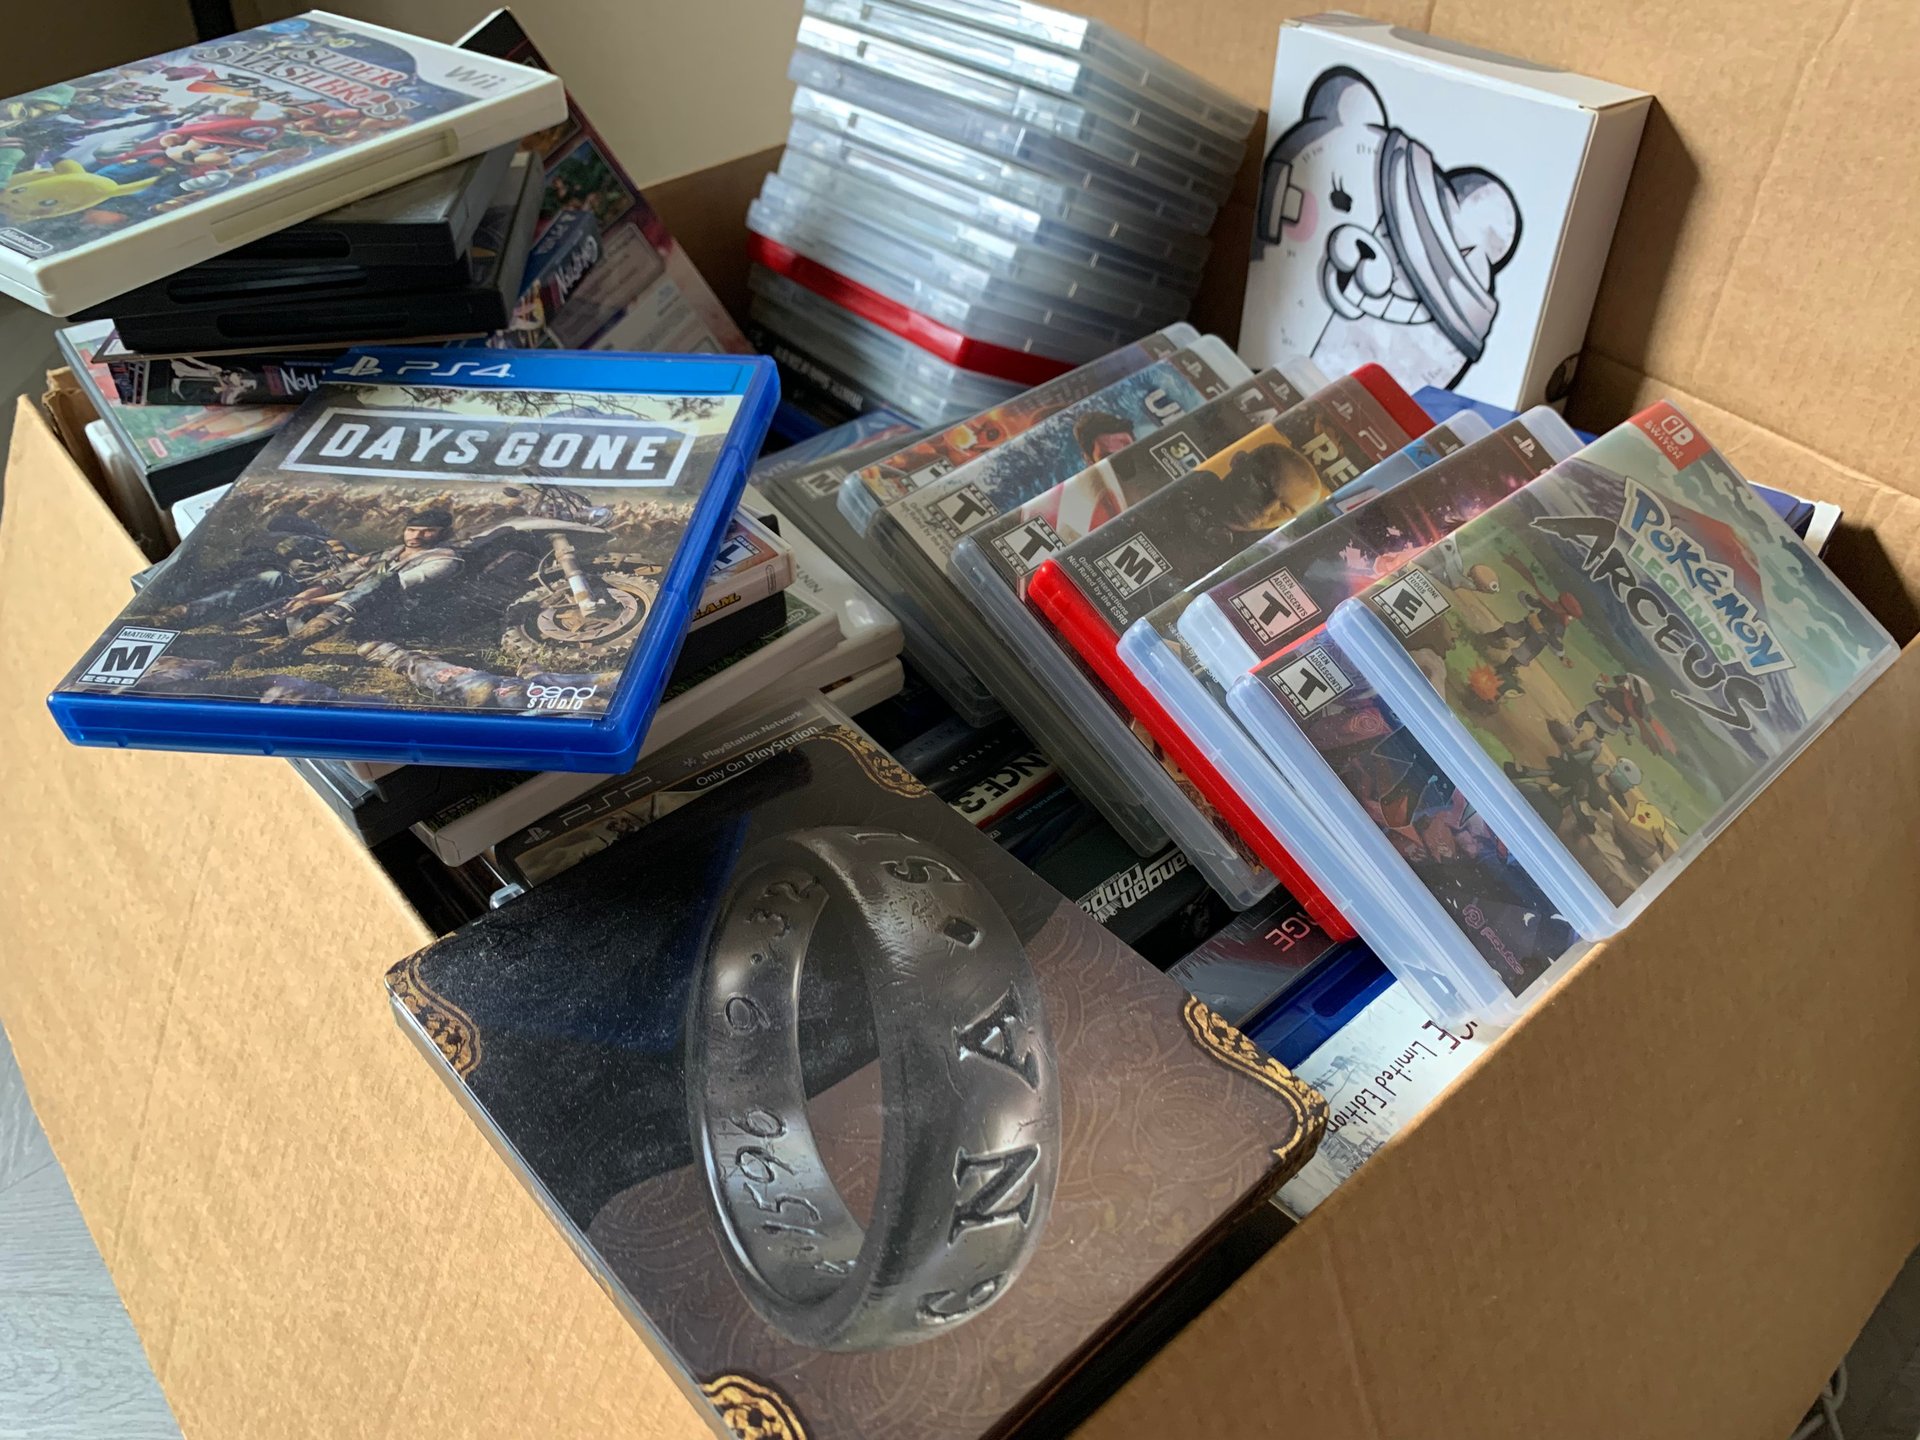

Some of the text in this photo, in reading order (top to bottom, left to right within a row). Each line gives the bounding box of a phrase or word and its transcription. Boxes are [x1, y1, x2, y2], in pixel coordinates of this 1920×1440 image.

[190, 46, 318, 93] SMASH
[298, 49, 408, 88] SUPER
[444, 63, 507, 90] Wii
[397, 361, 512, 378] PS4
[318, 421, 668, 473] DAYS GONE
[1644, 419, 1685, 460] SWITCH
[952, 491, 987, 526] T
[1019, 524, 1056, 562] T
[1136, 535, 1158, 560] MATURE
[1097, 560, 1129, 598] ESRB
[1114, 544, 1155, 586] M
[1279, 572, 1296, 590] TEEN
[1066, 555, 1129, 626] Not Rated by the ESRB
[1078, 556, 1129, 616] Online Interactions
[1273, 576, 1309, 617] ADOLESCENTS
[1392, 587, 1424, 623] E
[1407, 576, 1427, 596] TODOS
[1413, 572, 1440, 600] EVERYONE
[1630, 544, 1737, 662] LEGENDS
[1231, 597, 1270, 643] ESRB
[1258, 590, 1293, 627] T
[1529, 515, 1768, 731] ARCEUS
[122, 630, 158, 640] MATURE
[101, 645, 154, 673] M
[1308, 653, 1344, 693] ADOLESCENTS
[1315, 648, 1332, 666] TEEN
[80, 675, 136, 686] ESRB
[527, 682, 598, 700] bend
[1271, 675, 1309, 717] ESRB
[1297, 667, 1329, 701] T
[527, 697, 585, 711] STUDIO
[696, 724, 820, 788] Only On PlayStation
[558, 776, 654, 828] PSP
[1121, 852, 1191, 910] angan
[1374, 1040, 1438, 1097] Limited
[1325, 1088, 1388, 1134] Edition
